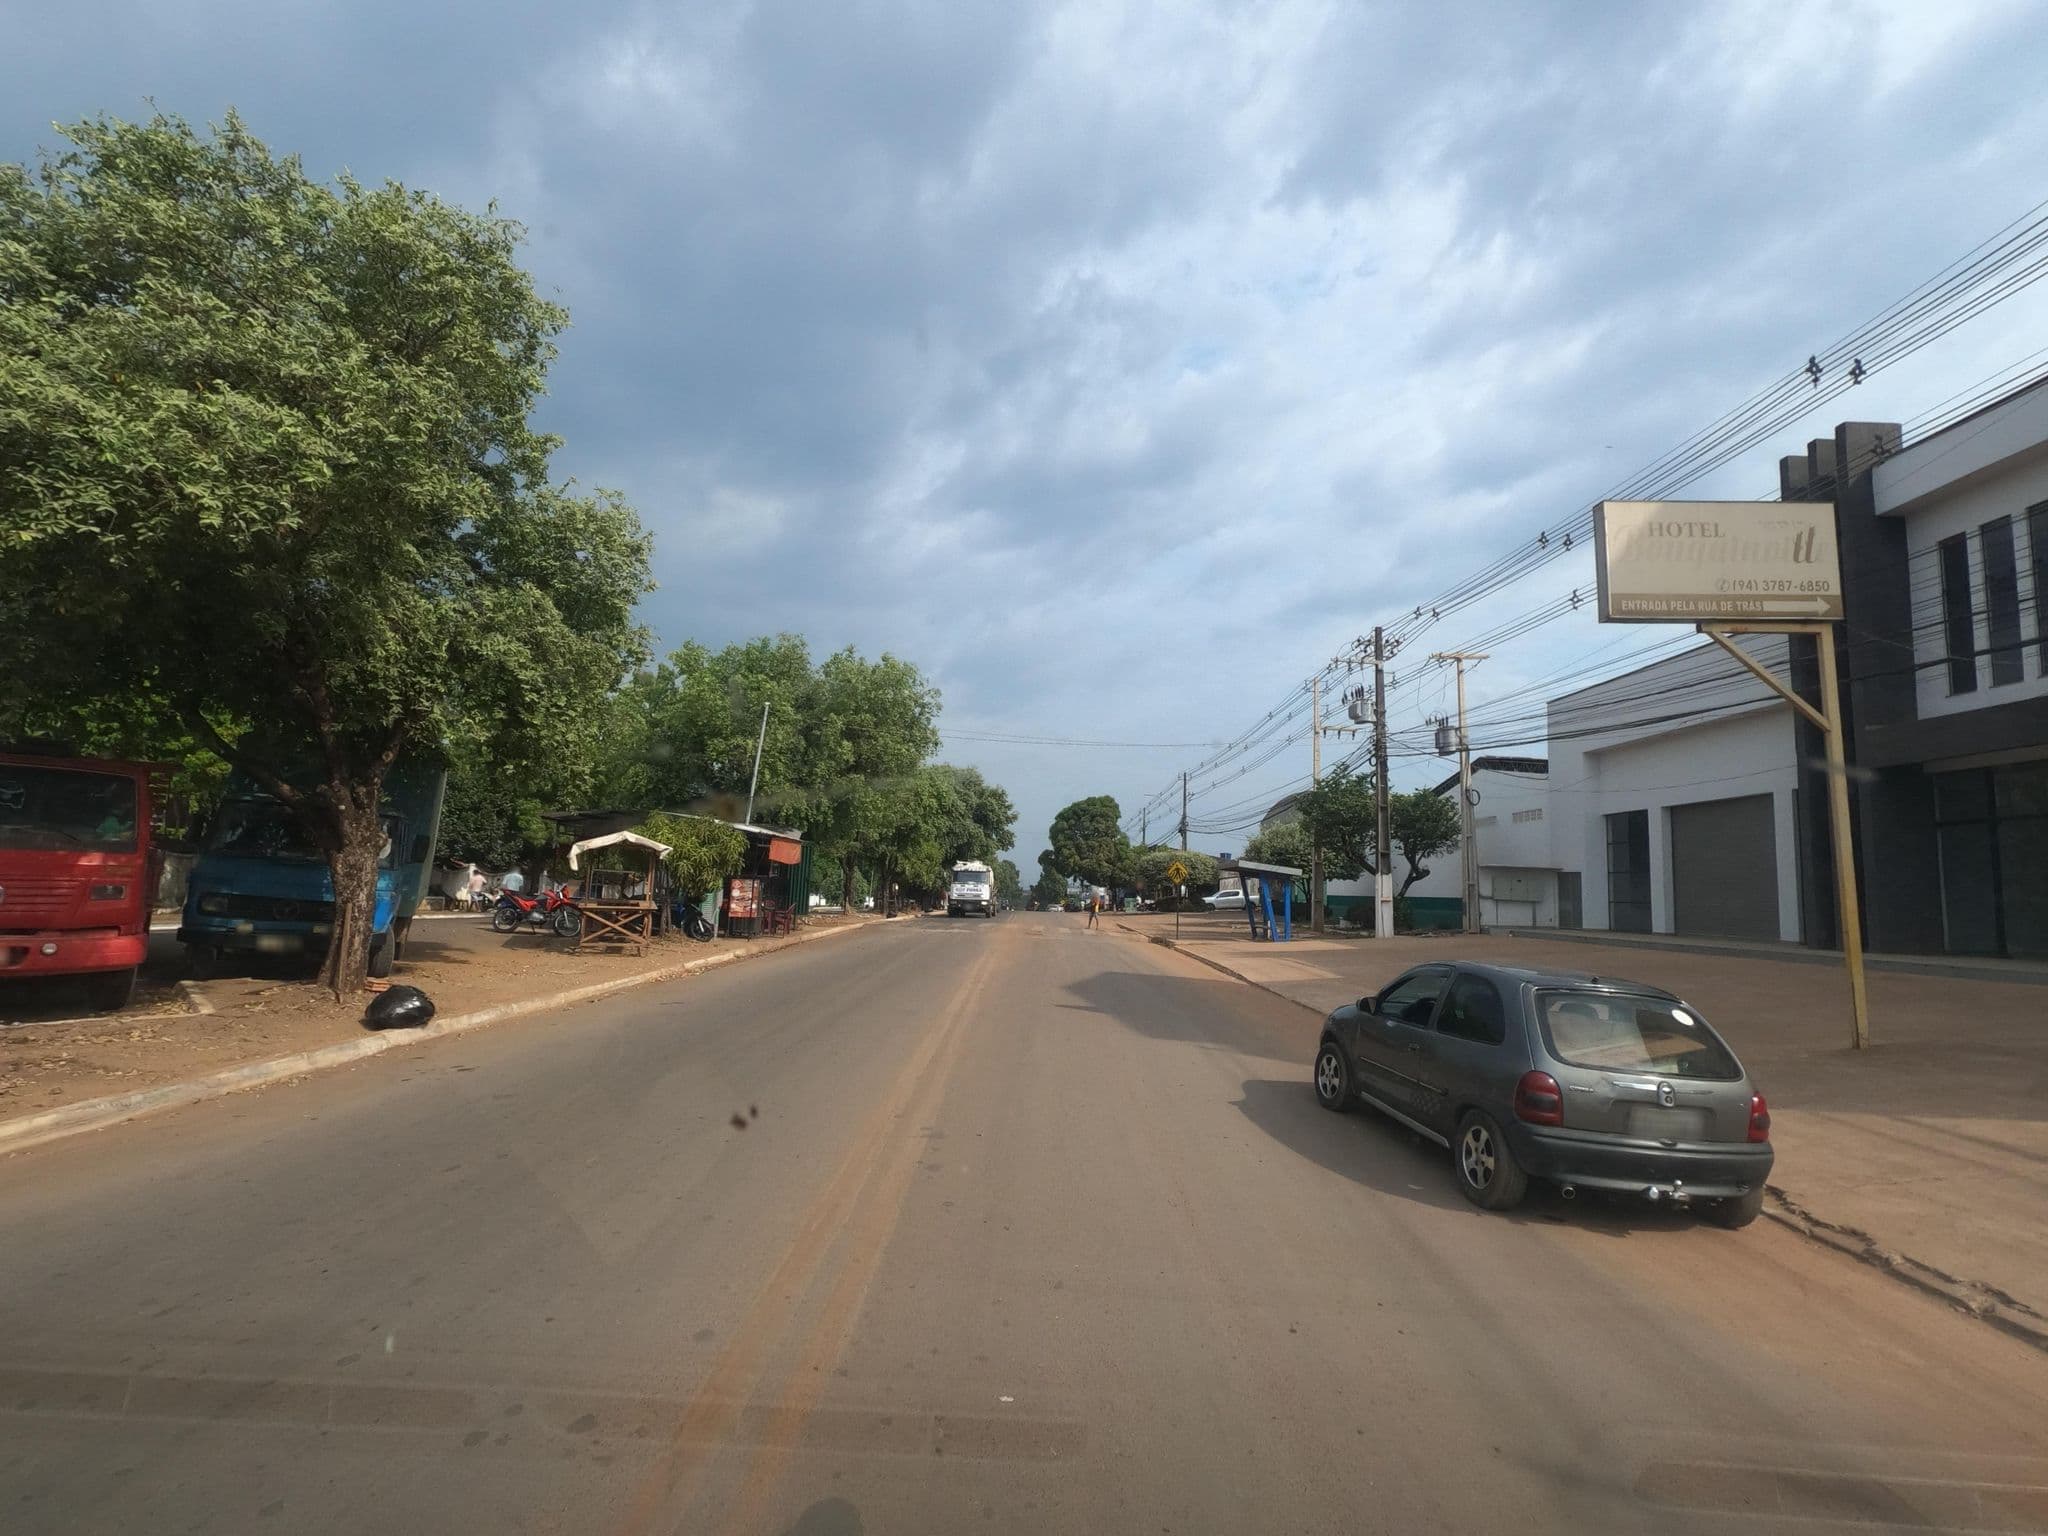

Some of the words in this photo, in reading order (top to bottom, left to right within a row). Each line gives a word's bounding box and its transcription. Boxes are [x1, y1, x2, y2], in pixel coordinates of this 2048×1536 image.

[1648, 521, 1725, 538] HOTEL
[1732, 580, 1759, 592] (94)
[1763, 580, 1830, 592] 3787-6850
[1622, 600, 1668, 611] ENTRADA
[1670, 600, 1696, 611] PELA
[1699, 600, 1719, 612] RUA
[1721, 600, 1733, 612] DE
